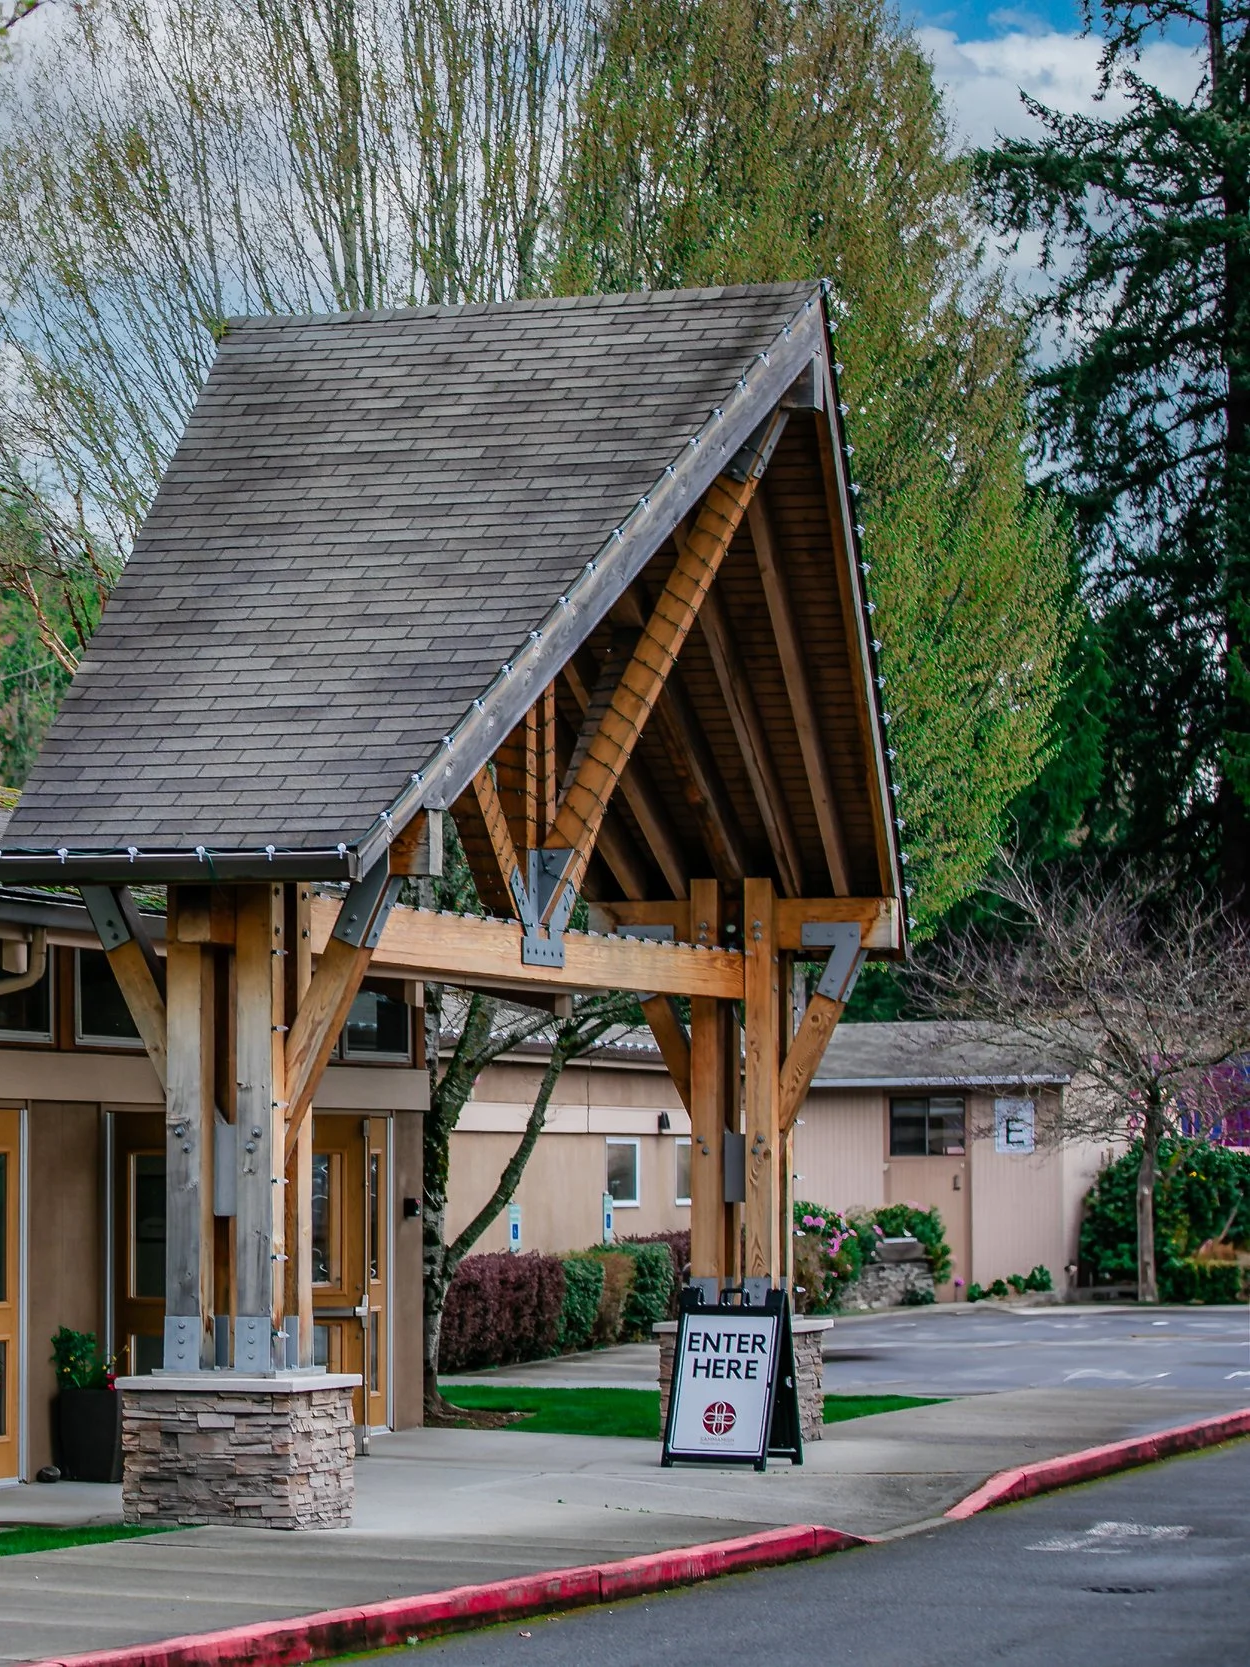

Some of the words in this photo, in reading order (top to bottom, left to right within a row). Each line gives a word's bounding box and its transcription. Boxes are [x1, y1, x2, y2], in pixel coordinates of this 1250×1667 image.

[1006, 1119, 1025, 1144] E
[688, 1332, 767, 1354] ENTER
[693, 1358, 759, 1380] HERE
